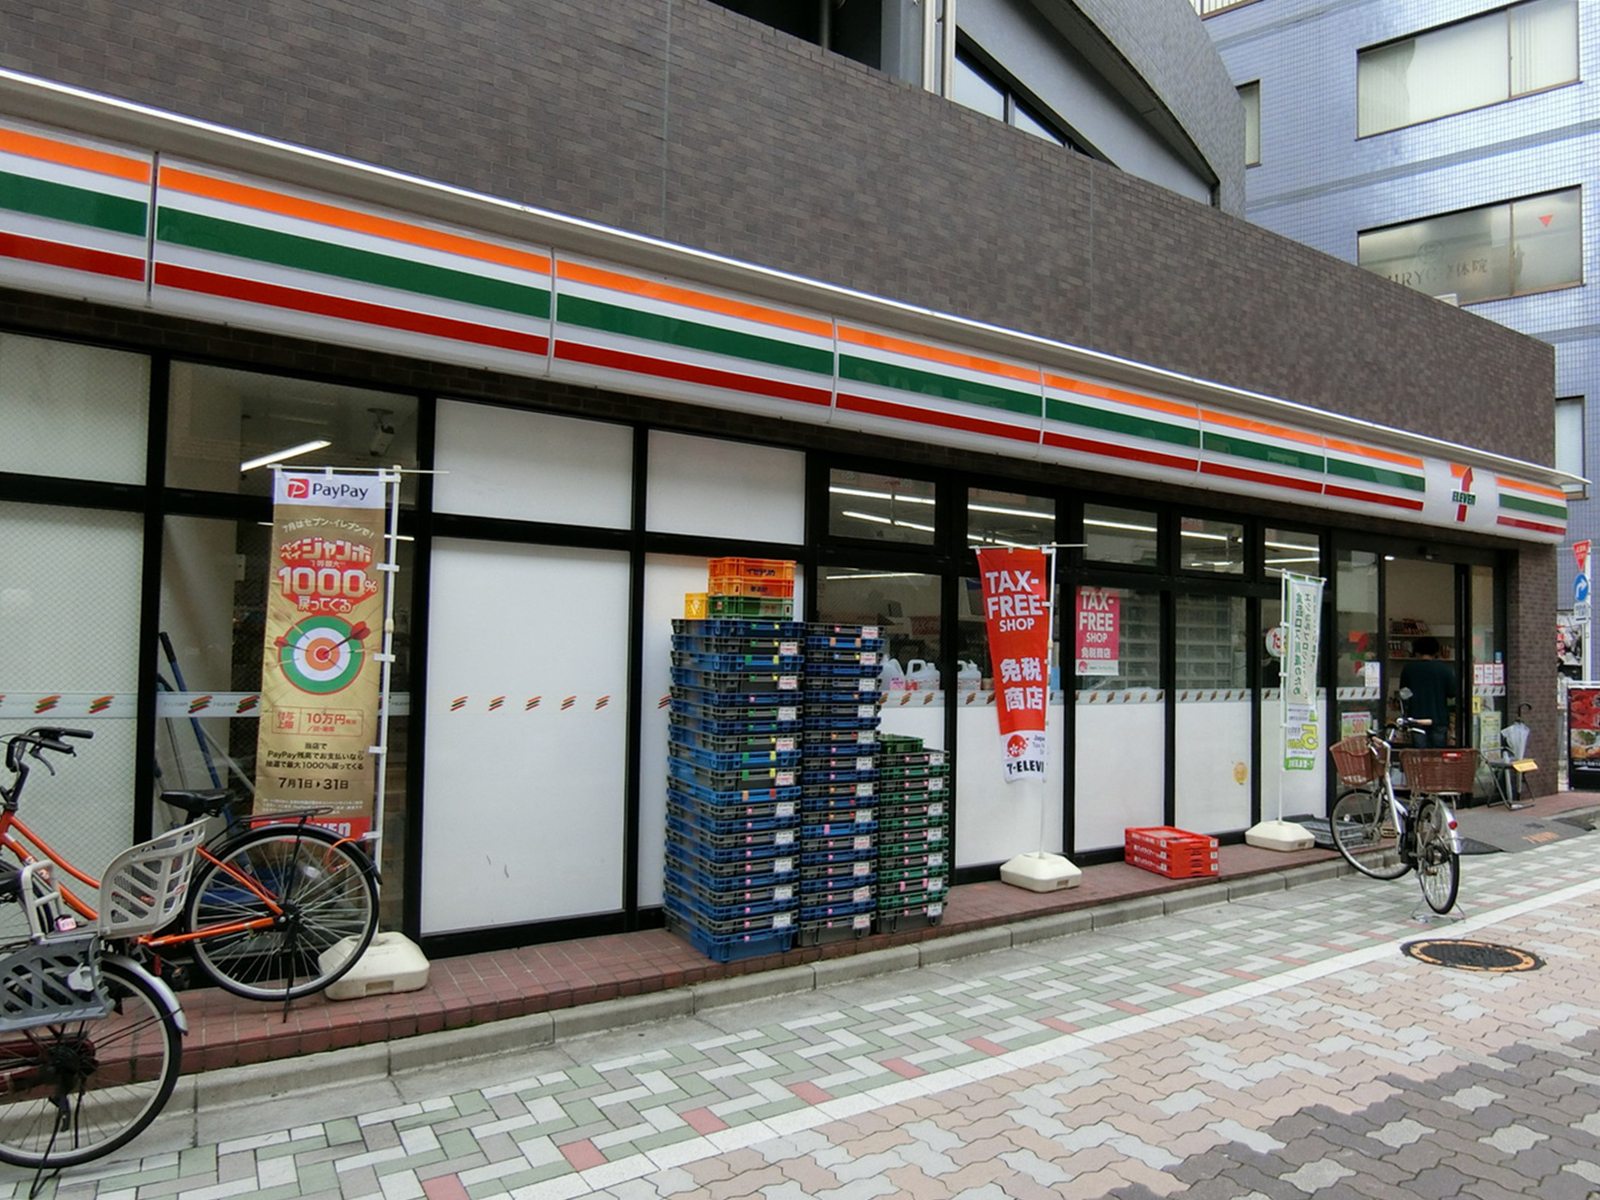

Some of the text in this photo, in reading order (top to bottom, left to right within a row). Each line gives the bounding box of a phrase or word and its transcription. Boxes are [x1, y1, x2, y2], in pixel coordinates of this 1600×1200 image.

[312, 482, 369, 501] PayPay
[278, 566, 378, 598] 1000%
[985, 570, 1039, 594] TAX-
[987, 594, 1044, 620] FREE
[1080, 591, 1114, 611] TAX-
[999, 618, 1036, 633] SHOP
[1079, 611, 1114, 632] FREE
[1086, 632, 1108, 644] SHOP
[1000, 657, 1043, 684] 免税
[1004, 686, 1043, 712] 商店
[305, 742, 327, 750] 当店で
[1006, 760, 1045, 775] 7-ELEV
